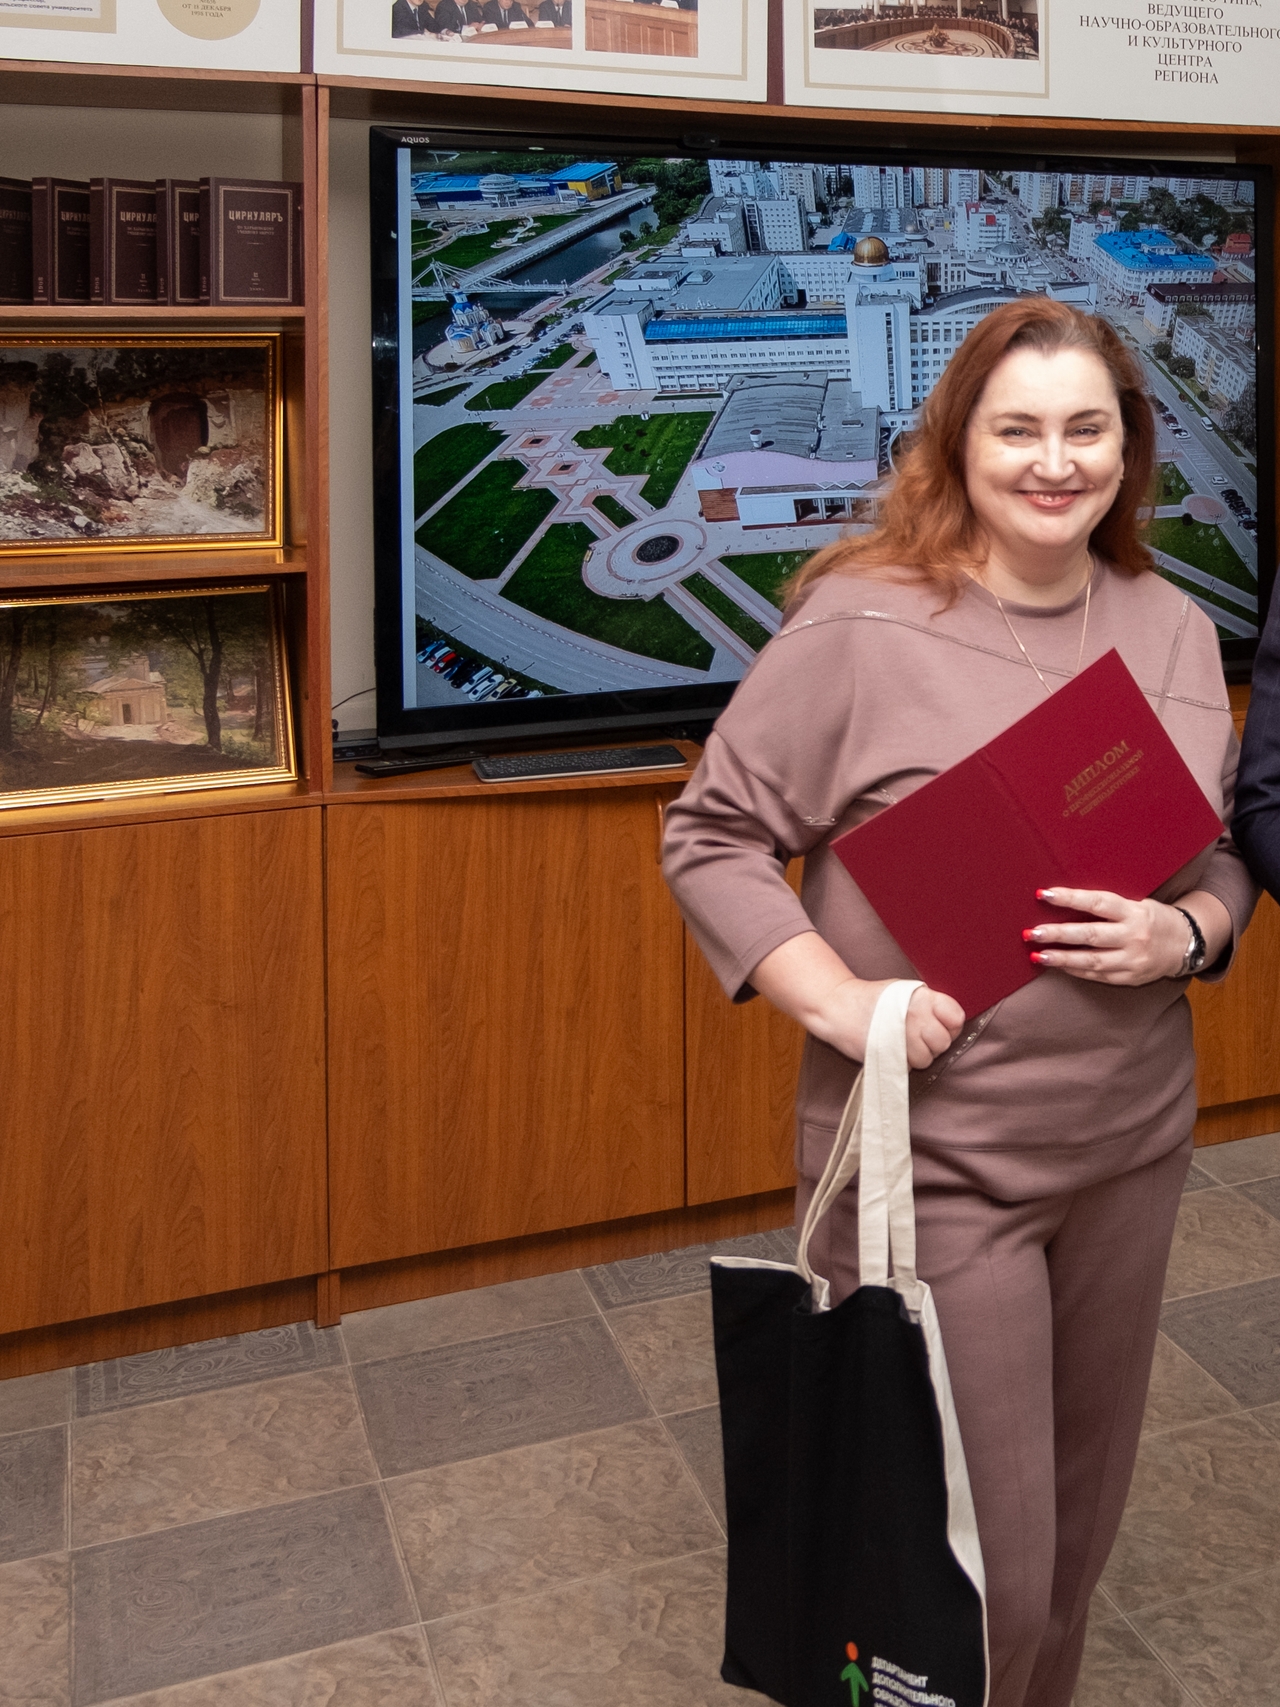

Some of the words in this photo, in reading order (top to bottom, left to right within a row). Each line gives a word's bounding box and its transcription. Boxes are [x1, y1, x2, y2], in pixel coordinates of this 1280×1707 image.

[1147, 3, 1224, 19] ВЕДУЩЕГО
[1128, 35, 1138, 47] И
[1142, 36, 1243, 53] КУЛЬТУРНОГО
[1157, 53, 1213, 68] ЦЕНТРА
[1154, 70, 1219, 84] РЕГИОНА
[401, 136, 430, 145] AQUOS
[1063, 740, 1130, 802] ДИПЛОМ
